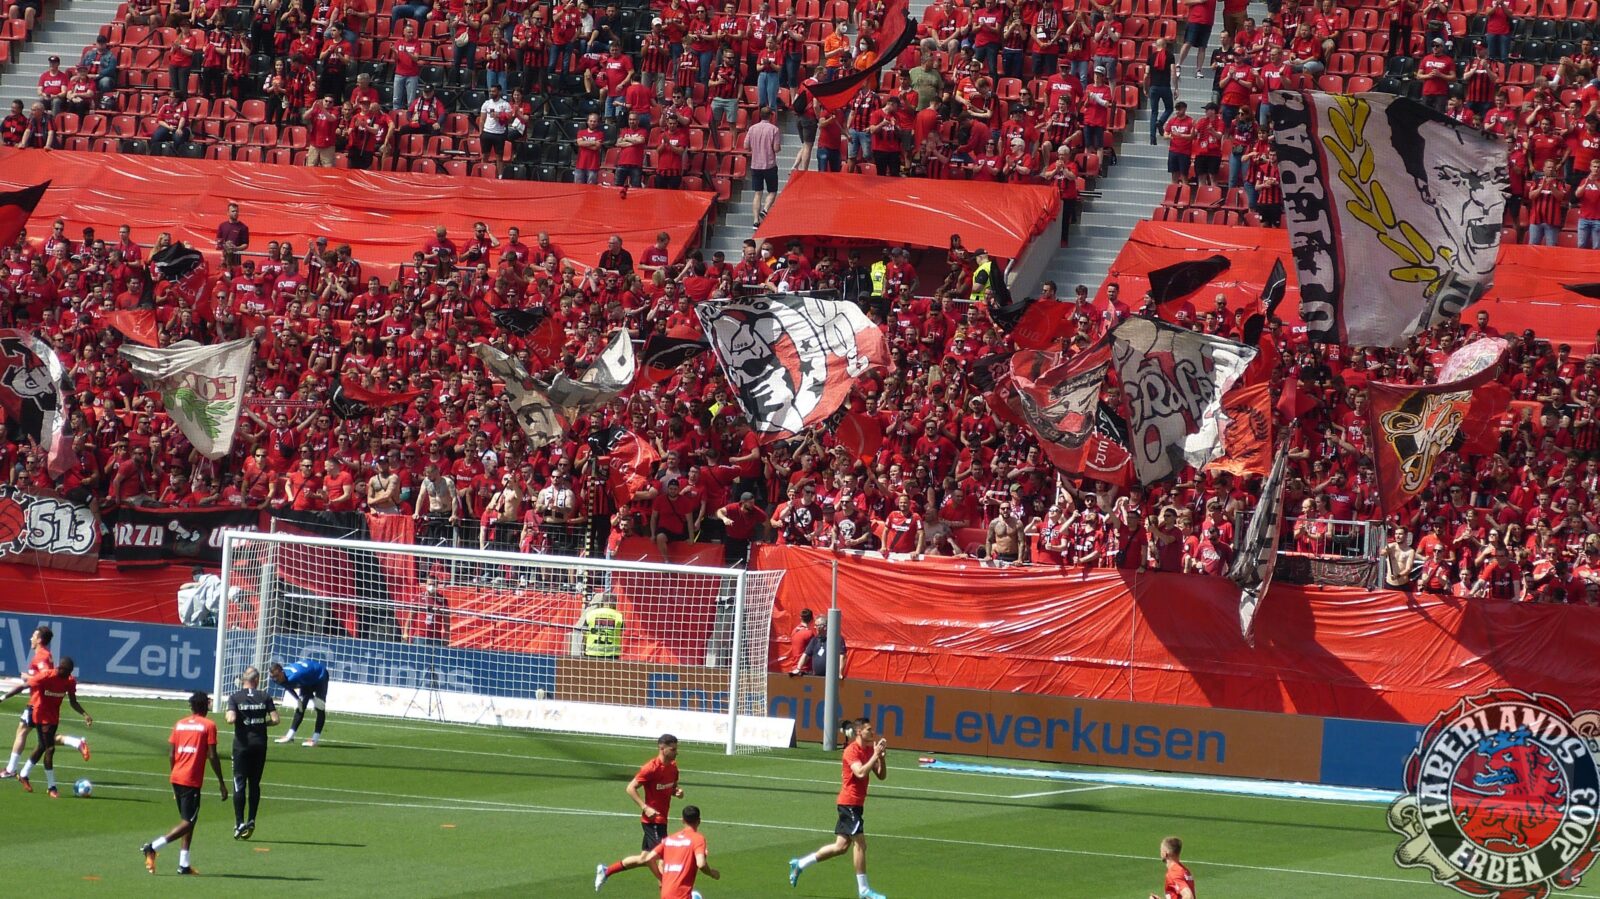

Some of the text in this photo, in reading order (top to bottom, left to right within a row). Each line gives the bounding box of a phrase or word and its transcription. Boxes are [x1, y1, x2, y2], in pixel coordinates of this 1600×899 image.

[28, 499, 97, 553] 513
[113, 523, 164, 547] RZA
[106, 629, 201, 680] Zeit
[864, 689, 902, 736] in
[924, 694, 1226, 764] Leverkusen
